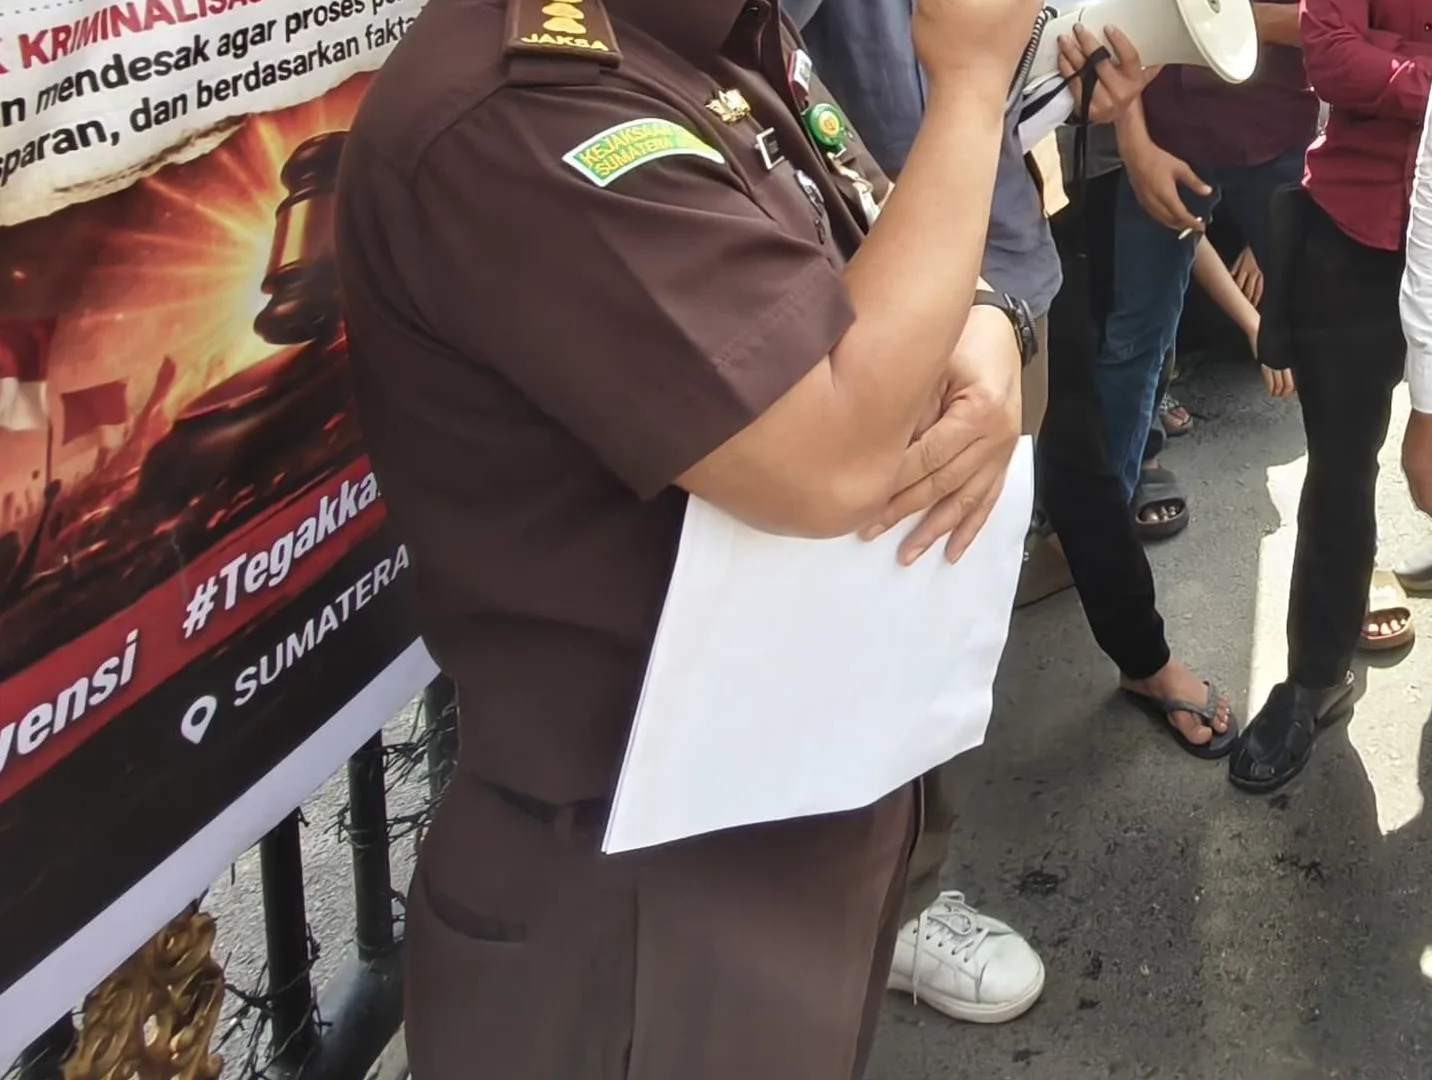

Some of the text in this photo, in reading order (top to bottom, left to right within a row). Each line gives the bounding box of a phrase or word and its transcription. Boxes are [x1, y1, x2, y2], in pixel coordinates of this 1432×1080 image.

[36, 36, 210, 115] mendesak
[216, 16, 277, 60] agar
[284, 0, 366, 45] proses
[129, 89, 189, 133] dan
[196, 36, 361, 111] berdasarkan
[520, 33, 610, 51] JAKSA
[181, 471, 381, 639] #Tegakka
[233, 543, 410, 709] SUMATERA
